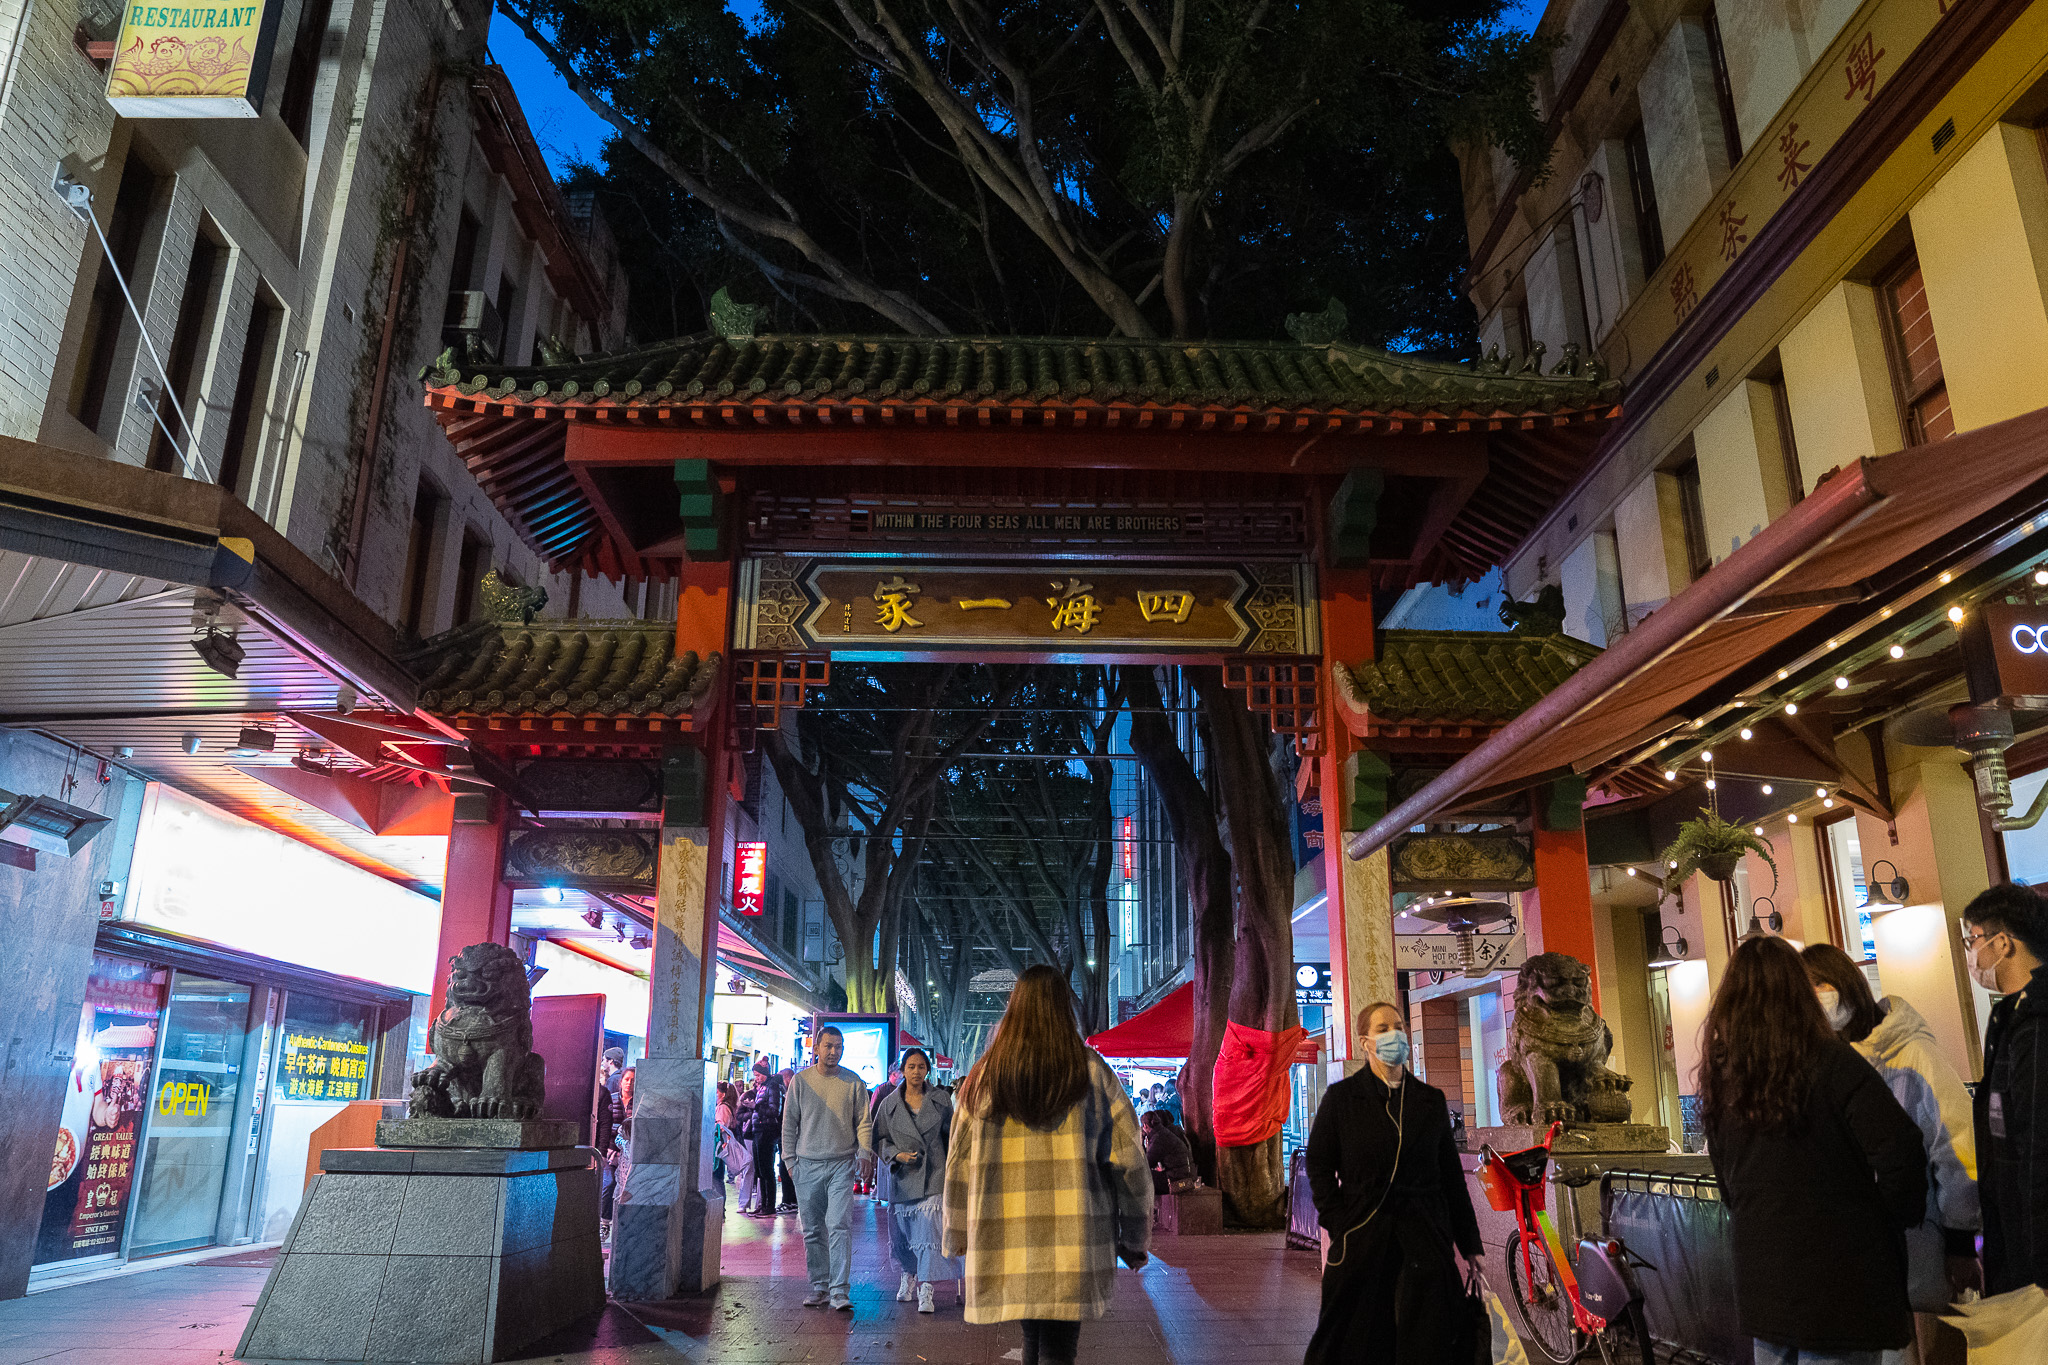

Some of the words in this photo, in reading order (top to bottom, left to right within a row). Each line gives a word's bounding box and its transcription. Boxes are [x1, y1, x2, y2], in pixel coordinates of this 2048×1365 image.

[129, 6, 256, 28] RESTAURANT
[876, 514, 914, 528] WITHIN
[921, 515, 944, 528] THE
[950, 515, 982, 529] FOUR
[988, 515, 1020, 529] SEAS
[1026, 516, 1050, 529] ALL
[1054, 516, 1081, 530] MEN
[1087, 516, 1111, 530] ARE
[1117, 516, 1179, 530] BROTHERS
[1432, 953, 1446, 961] HOT
[289, 1033, 318, 1049] Authentic
[318, 1036, 347, 1053] Cantonese
[347, 1040, 369, 1055] Cuisines
[284, 1052, 327, 1076] 早午茶市
[330, 1056, 367, 1079] 晚飯宵夜
[160, 1082, 210, 1116] OPEN
[93, 1133, 113, 1141] GREAT
[115, 1132, 134, 1141] VALUE
[89, 1144, 132, 1160] 經典味道
[79, 1210, 103, 1220] Emperor's
[103, 1209, 119, 1217] Garden
[85, 1226, 99, 1234] SINCE
